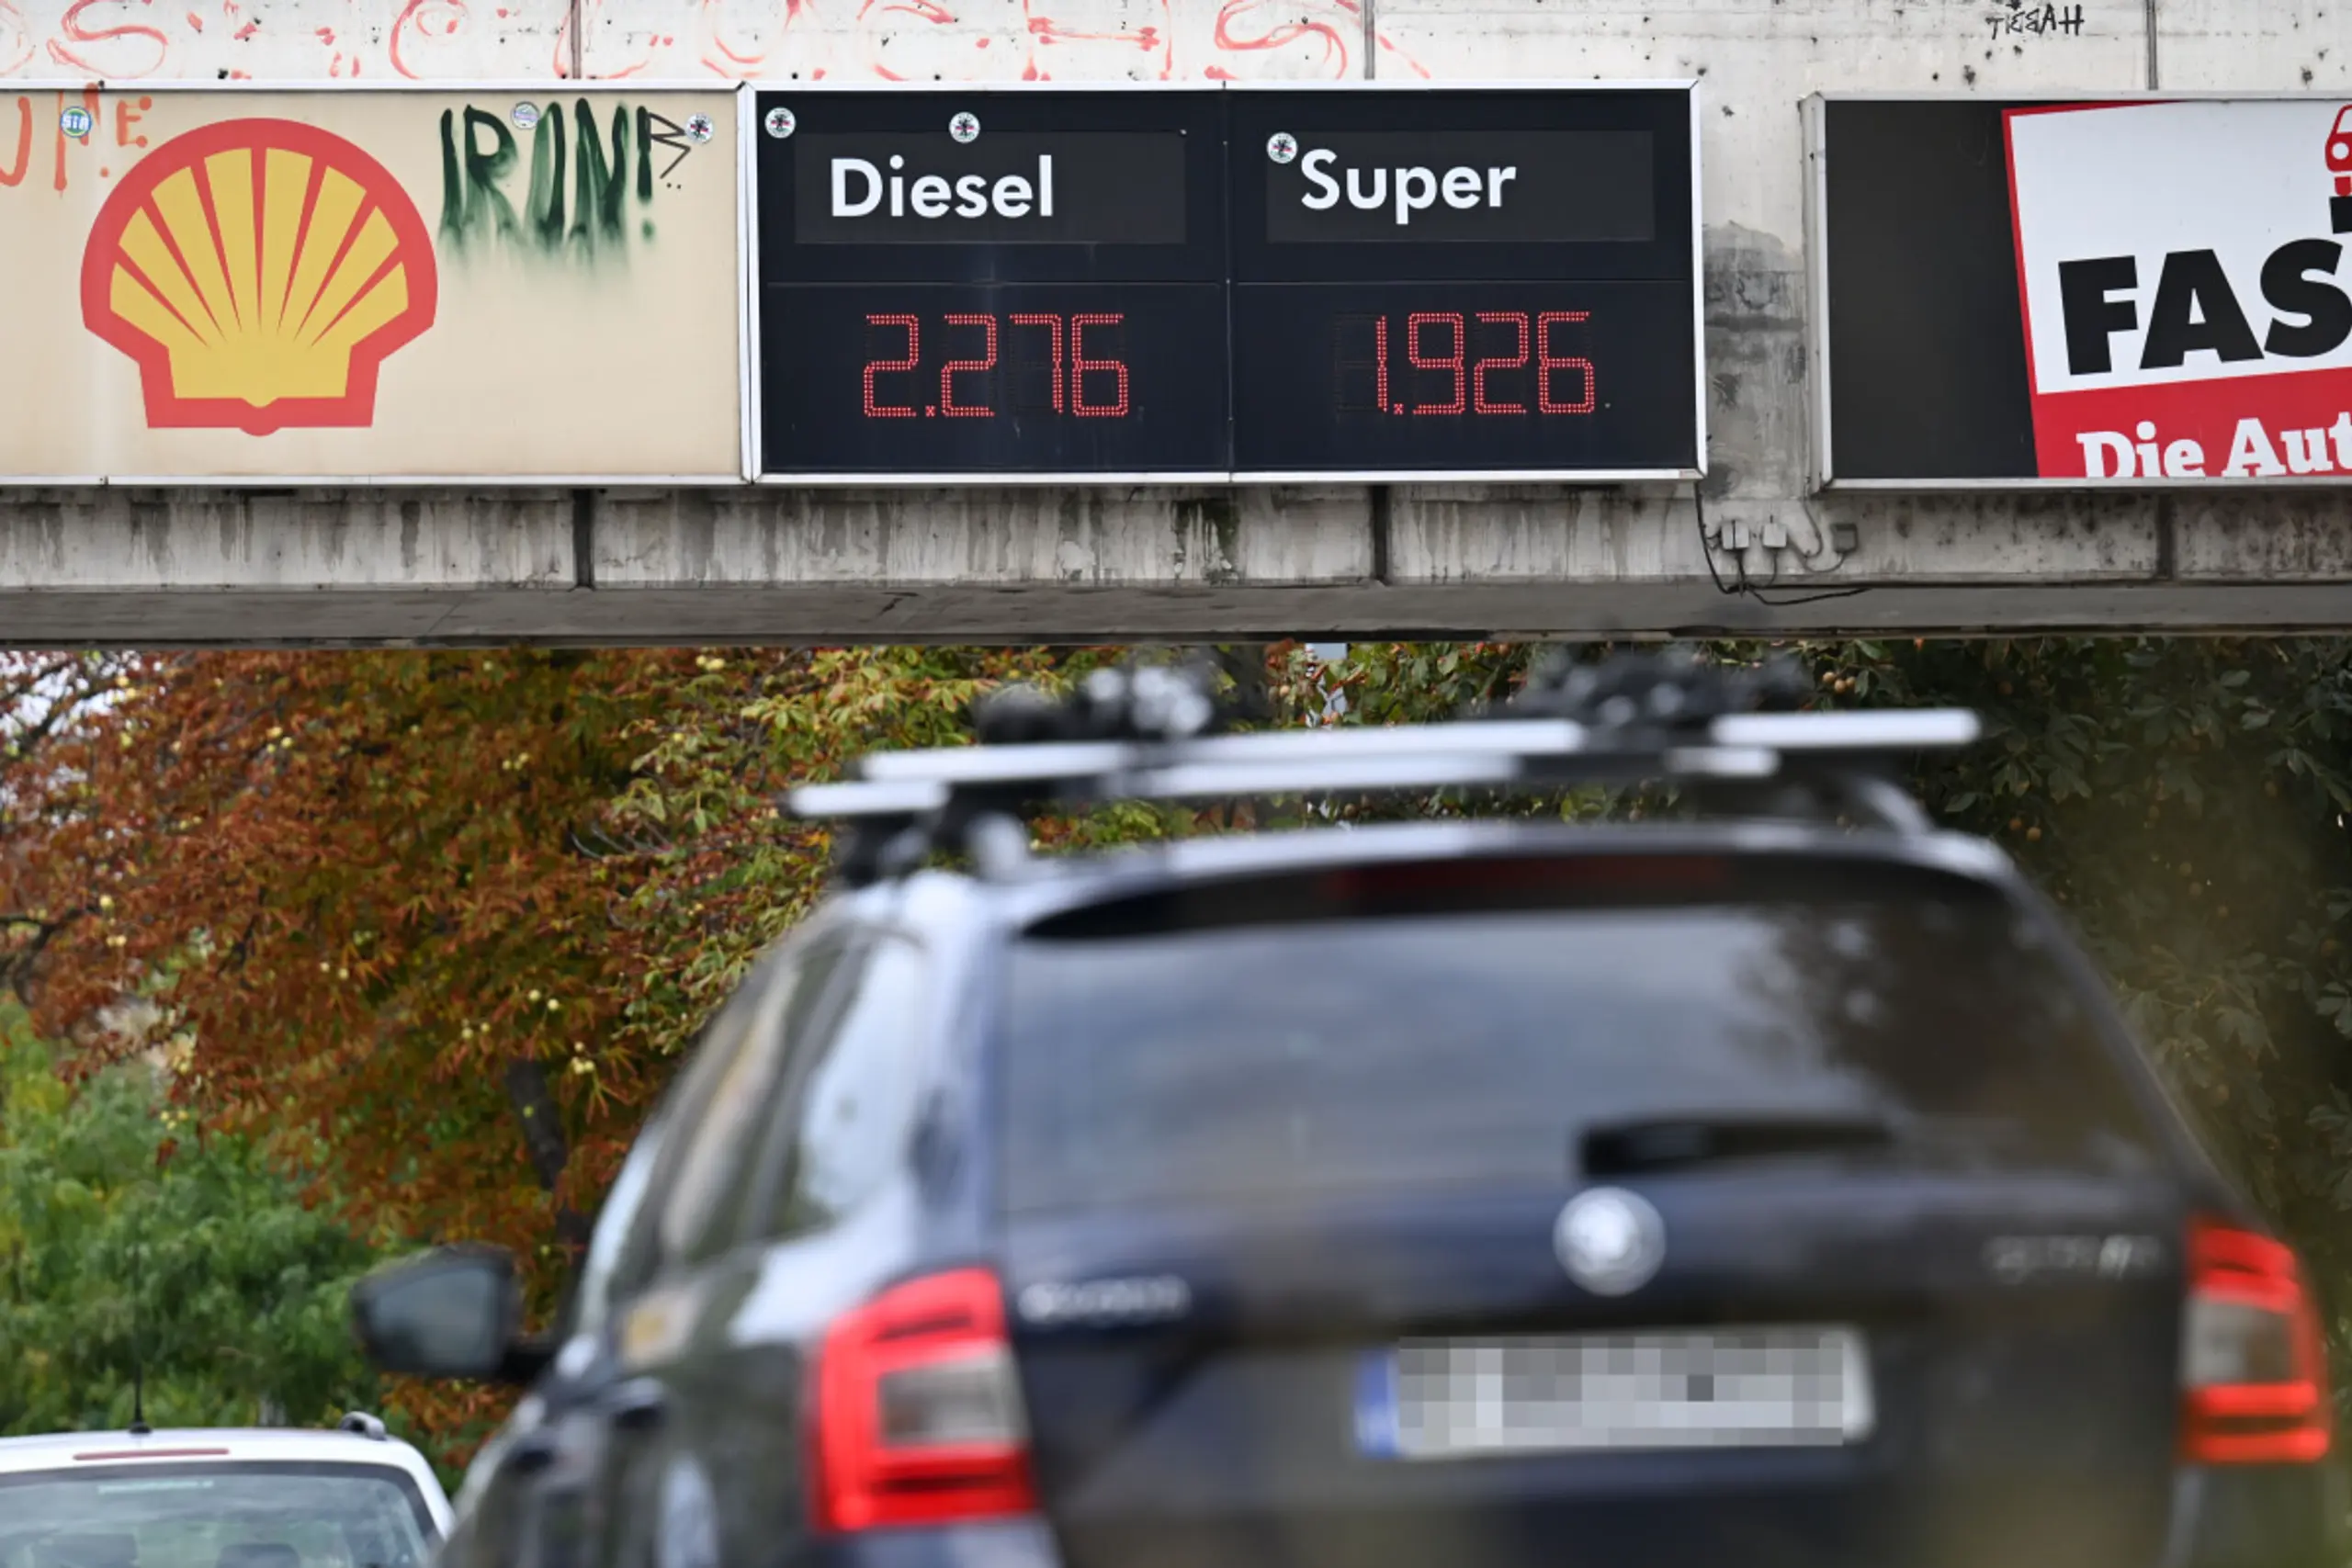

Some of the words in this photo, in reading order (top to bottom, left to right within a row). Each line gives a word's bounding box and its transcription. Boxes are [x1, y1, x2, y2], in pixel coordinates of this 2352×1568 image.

[831, 154, 1053, 219] Diesel
[1301, 149, 1517, 224] Super
[2058, 196, 2352, 376] FAS
[864, 314, 1129, 417] 2.276
[1375, 311, 1595, 414] 1.926
[2075, 421, 2206, 477] Die
